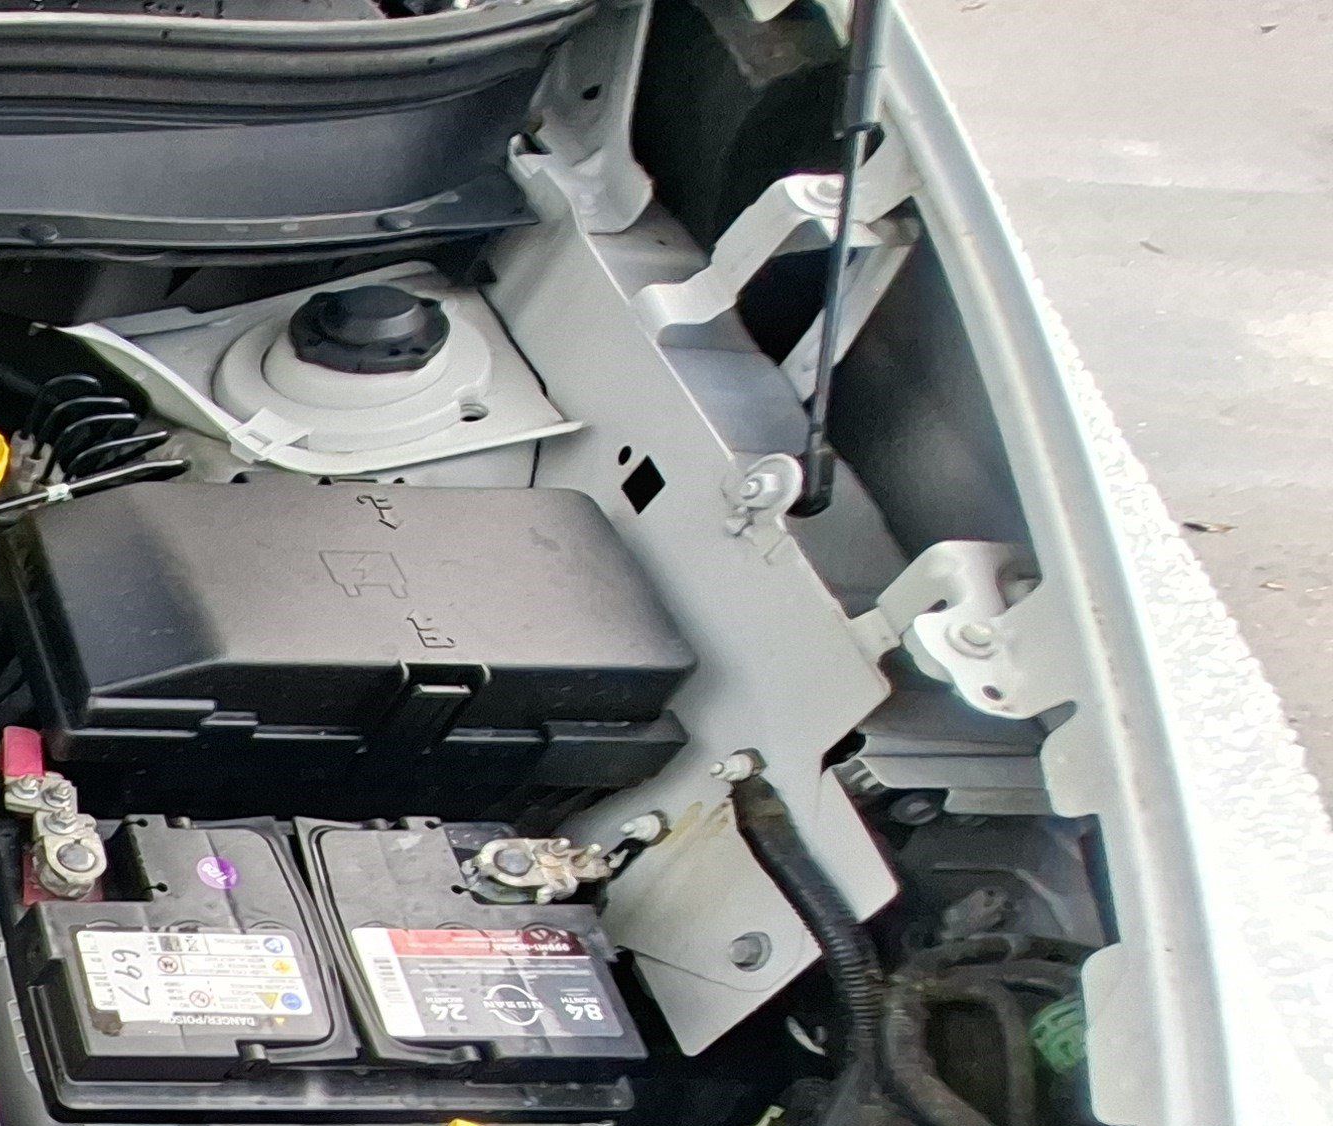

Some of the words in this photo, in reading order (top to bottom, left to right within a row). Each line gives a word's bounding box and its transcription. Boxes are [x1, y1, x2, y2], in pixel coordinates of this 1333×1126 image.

[429, 1003, 469, 1021] 24
[482, 999, 543, 1010] NISSAN
[565, 1003, 604, 1021] 84
